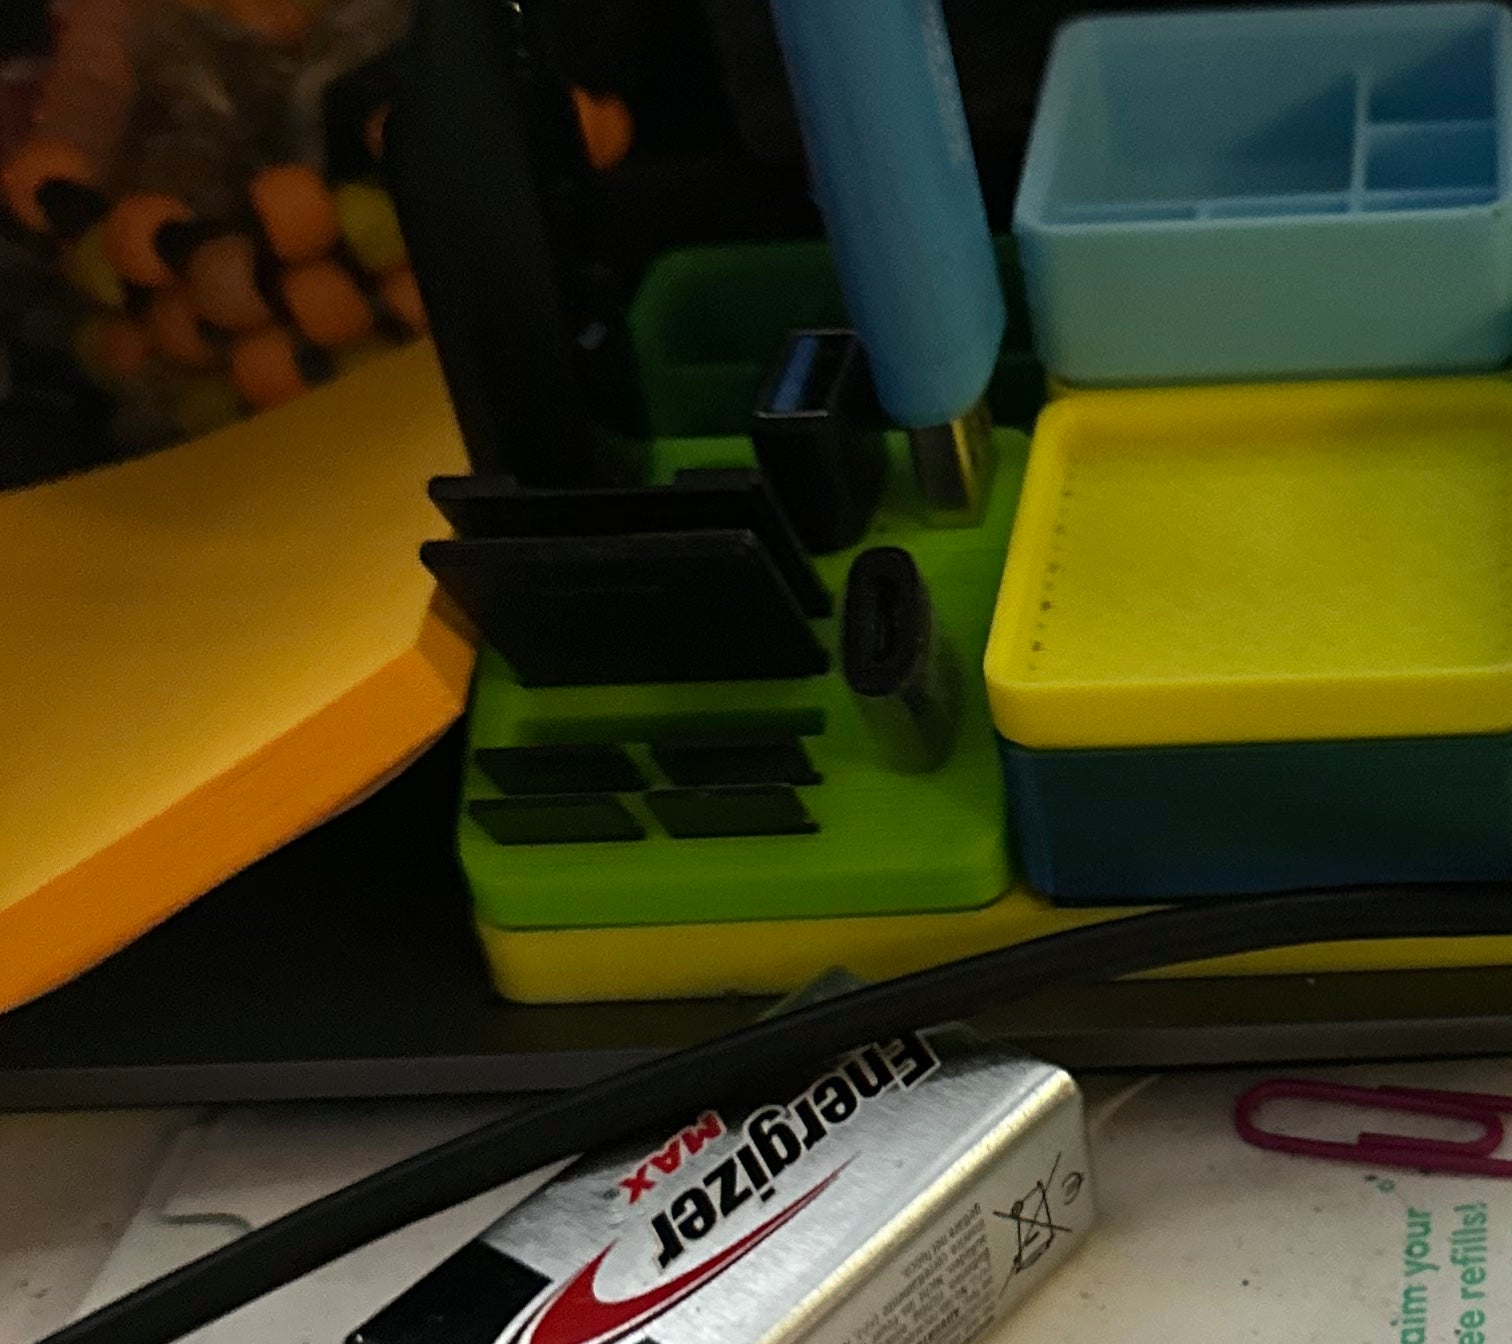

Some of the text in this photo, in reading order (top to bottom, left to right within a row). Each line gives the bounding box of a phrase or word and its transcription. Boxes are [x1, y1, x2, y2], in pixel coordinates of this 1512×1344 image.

[617, 1110, 725, 1205] MAX
[650, 1030, 940, 1271] Energizer
[1404, 1205, 1441, 1274] your
[1449, 1201, 1489, 1306] refills!
